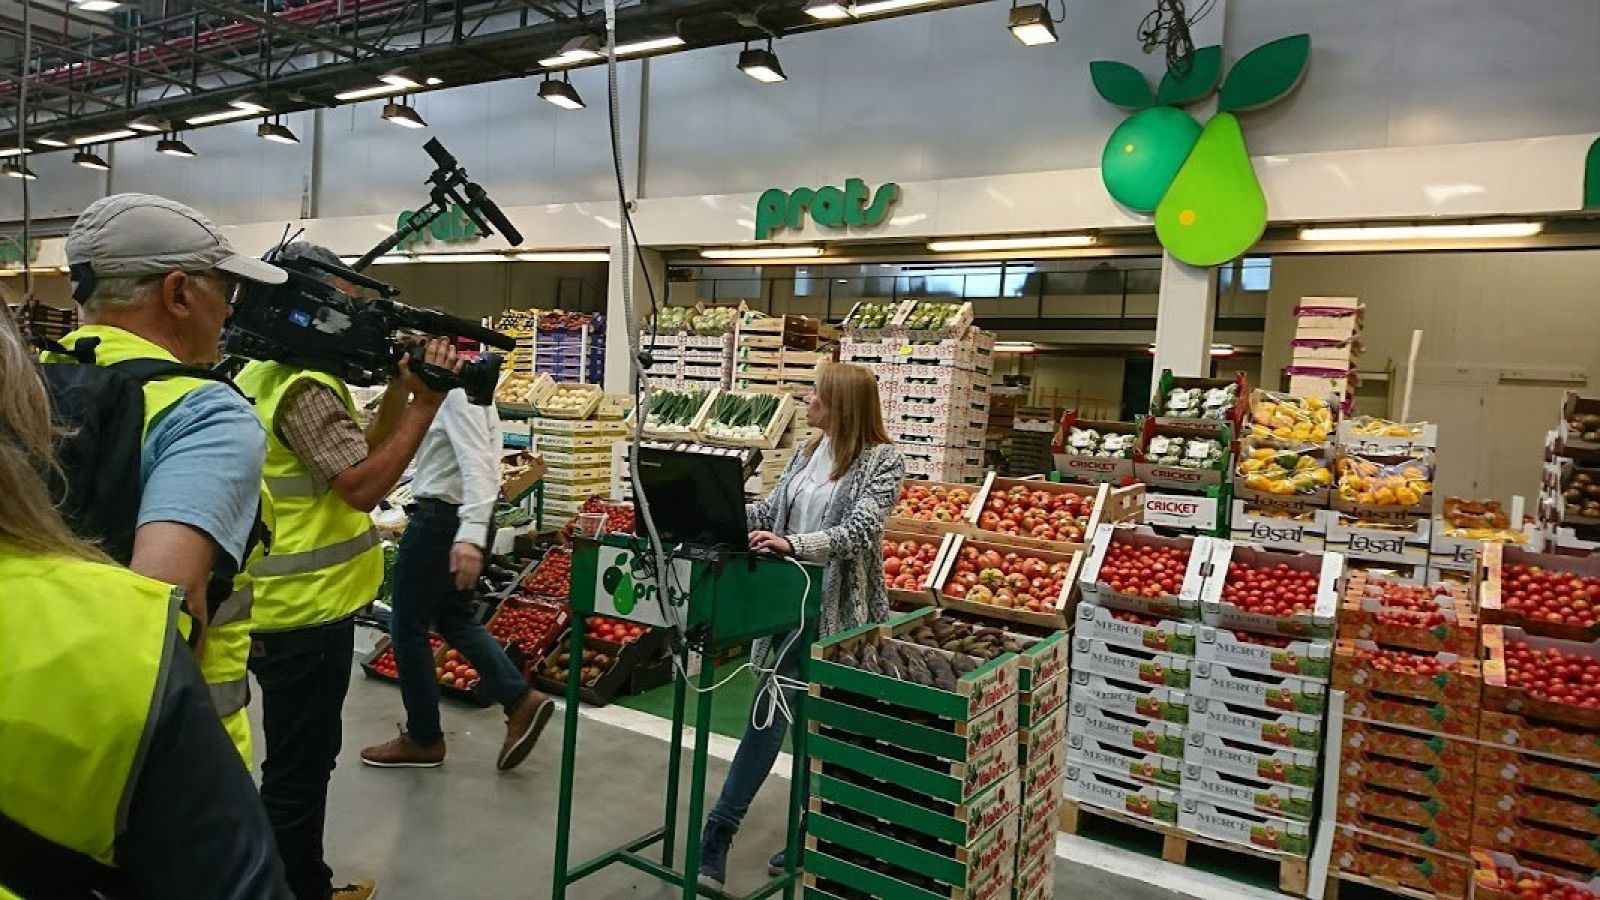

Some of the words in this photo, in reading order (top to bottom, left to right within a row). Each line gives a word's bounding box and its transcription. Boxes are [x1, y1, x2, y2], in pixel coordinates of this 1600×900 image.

[755, 178, 899, 240] prats
[1069, 460, 1117, 472] CRICKET
[1151, 469, 1201, 481] CRICKET
[1146, 500, 1199, 514] CRICKET
[632, 582, 690, 607] prts
